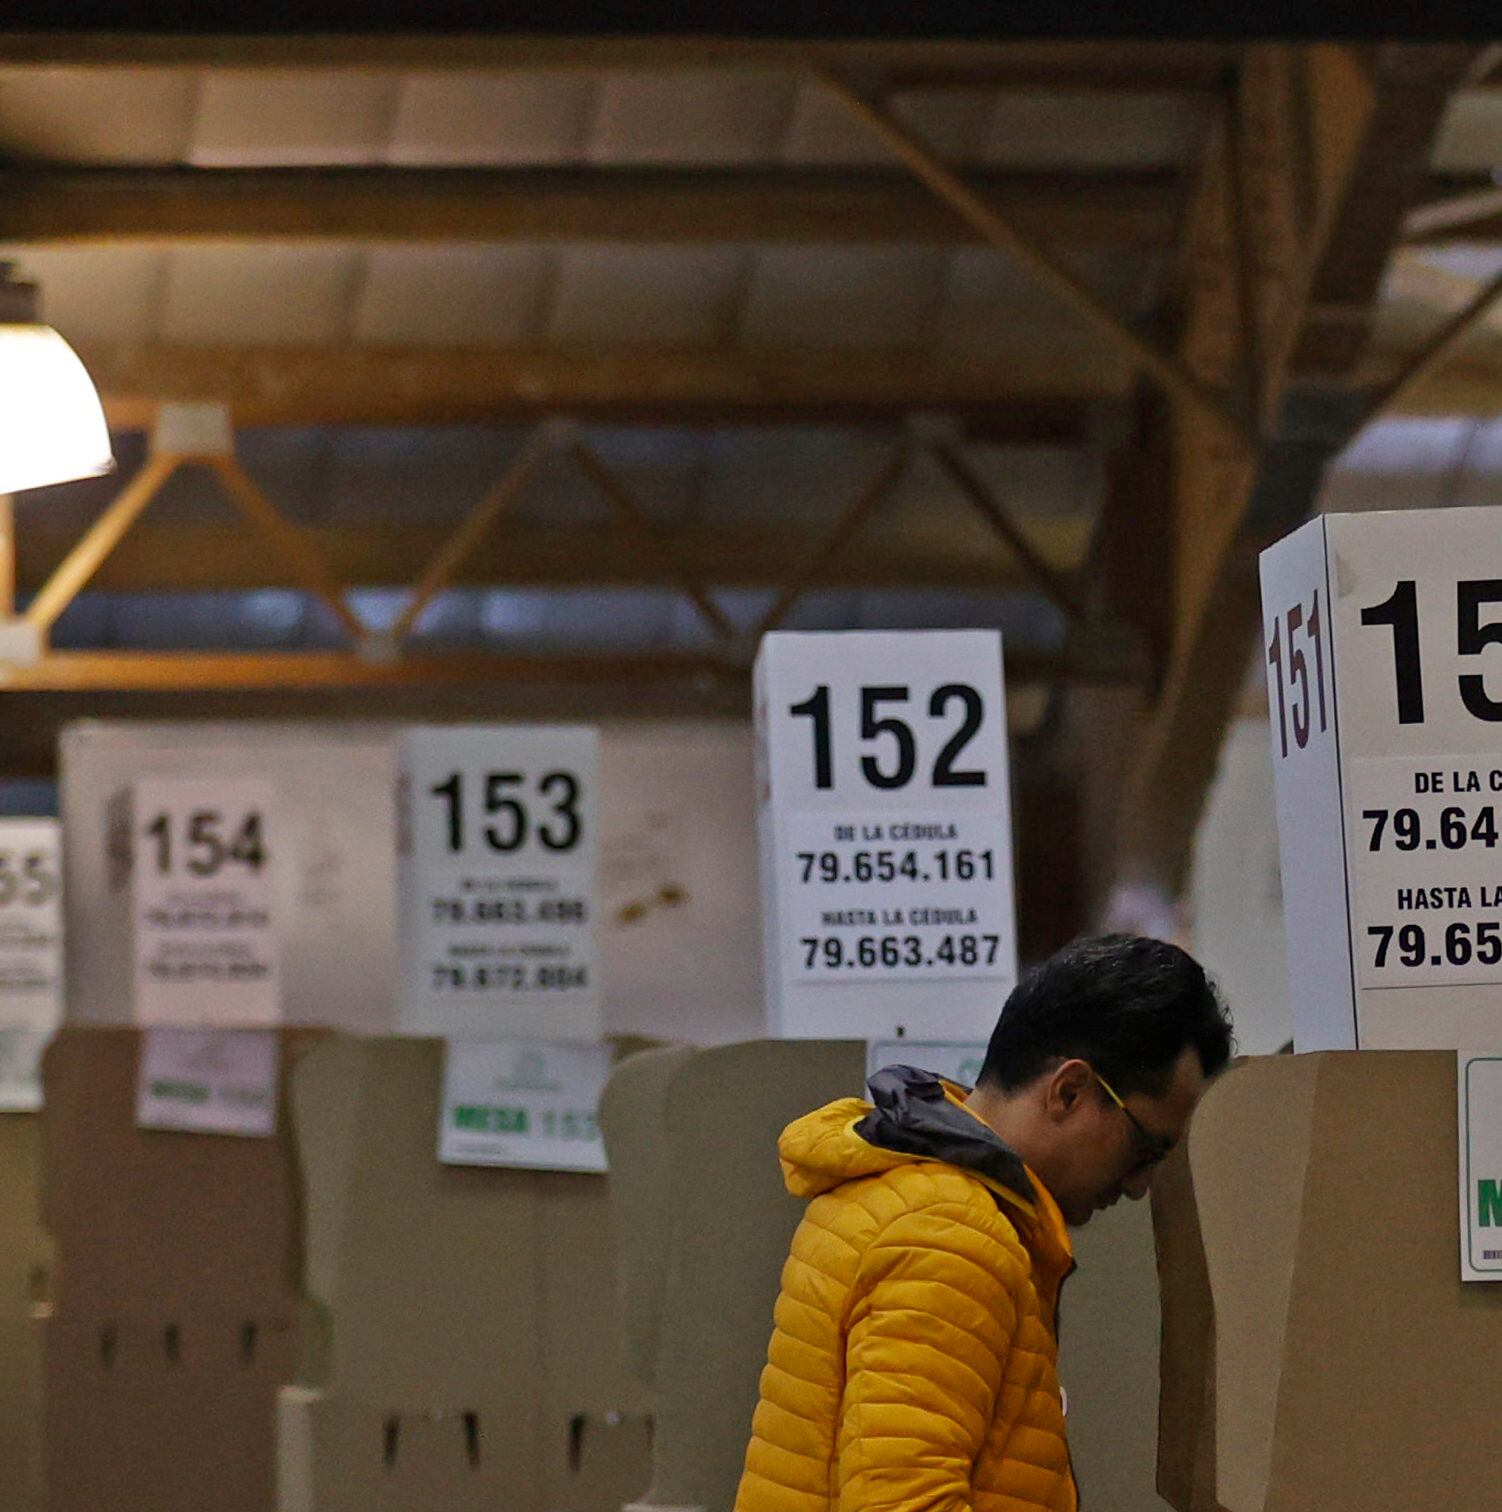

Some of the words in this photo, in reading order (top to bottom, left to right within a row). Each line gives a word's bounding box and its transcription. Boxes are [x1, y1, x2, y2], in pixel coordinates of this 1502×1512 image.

[1268, 588, 1328, 758] 151
[789, 683, 987, 791] 152
[1414, 771, 1444, 794] DE
[1453, 770, 1481, 793] LA
[432, 771, 583, 853] 153
[147, 812, 267, 876] 154
[834, 825, 855, 842] DE
[863, 825, 883, 841] LA
[798, 850, 994, 883] 79.654.161
[1397, 886, 1472, 910] HASTA
[883, 910, 904, 925] LA
[801, 935, 1000, 969] 79.663.487
